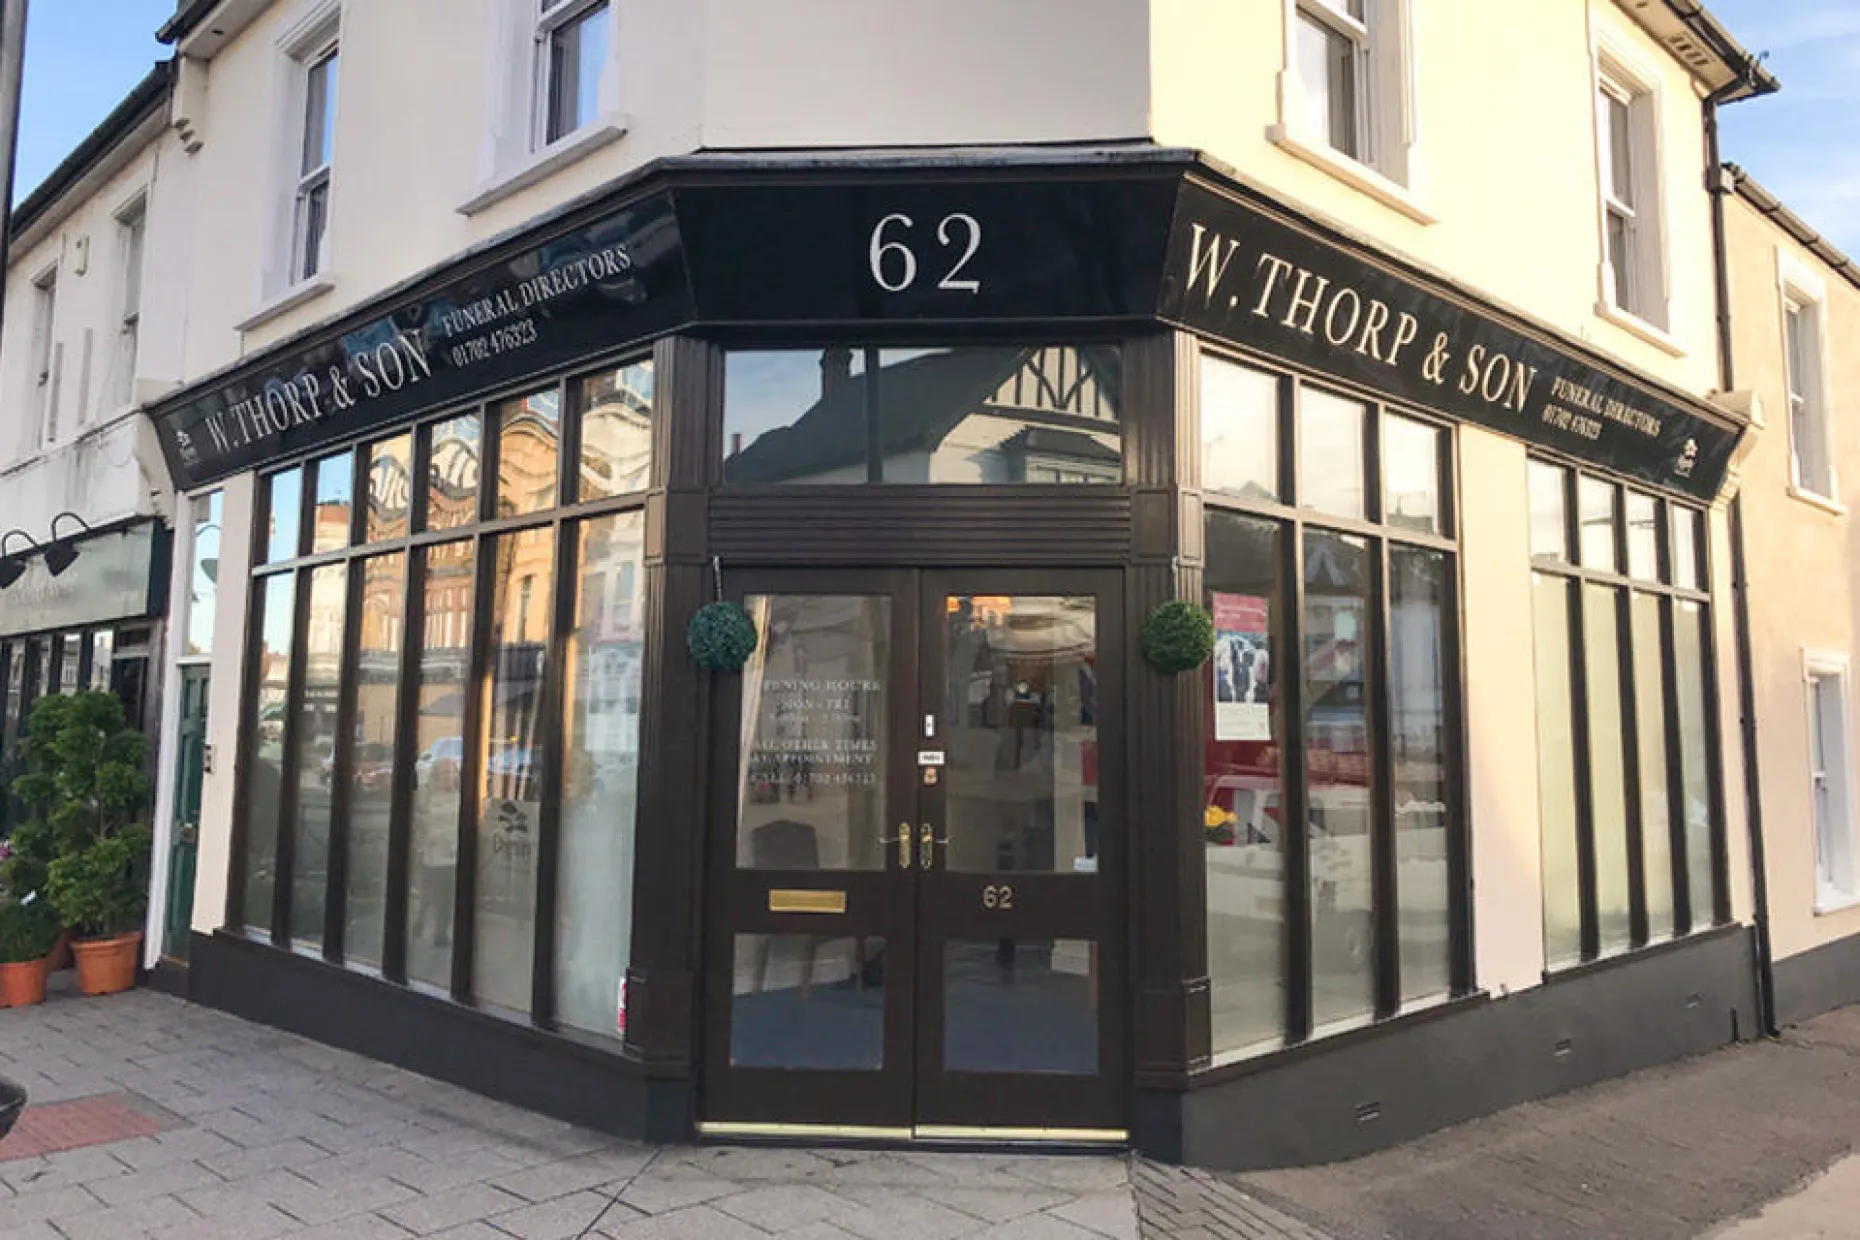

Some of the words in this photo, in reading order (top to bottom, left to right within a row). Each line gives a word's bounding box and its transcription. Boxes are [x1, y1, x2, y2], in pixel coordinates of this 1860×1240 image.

[441, 289, 519, 338] FUNERAL
[518, 243, 631, 307] DIRECTORS
[869, 212, 981, 294] 62
[1251, 251, 1417, 366] THORP
[1421, 331, 1450, 385] &
[1458, 344, 1538, 413] SON
[230, 373, 323, 445] THORP
[328, 365, 356, 410] &
[354, 328, 432, 398] SON
[1551, 376, 1604, 414] FUNERAL
[982, 885, 1013, 909] 62
